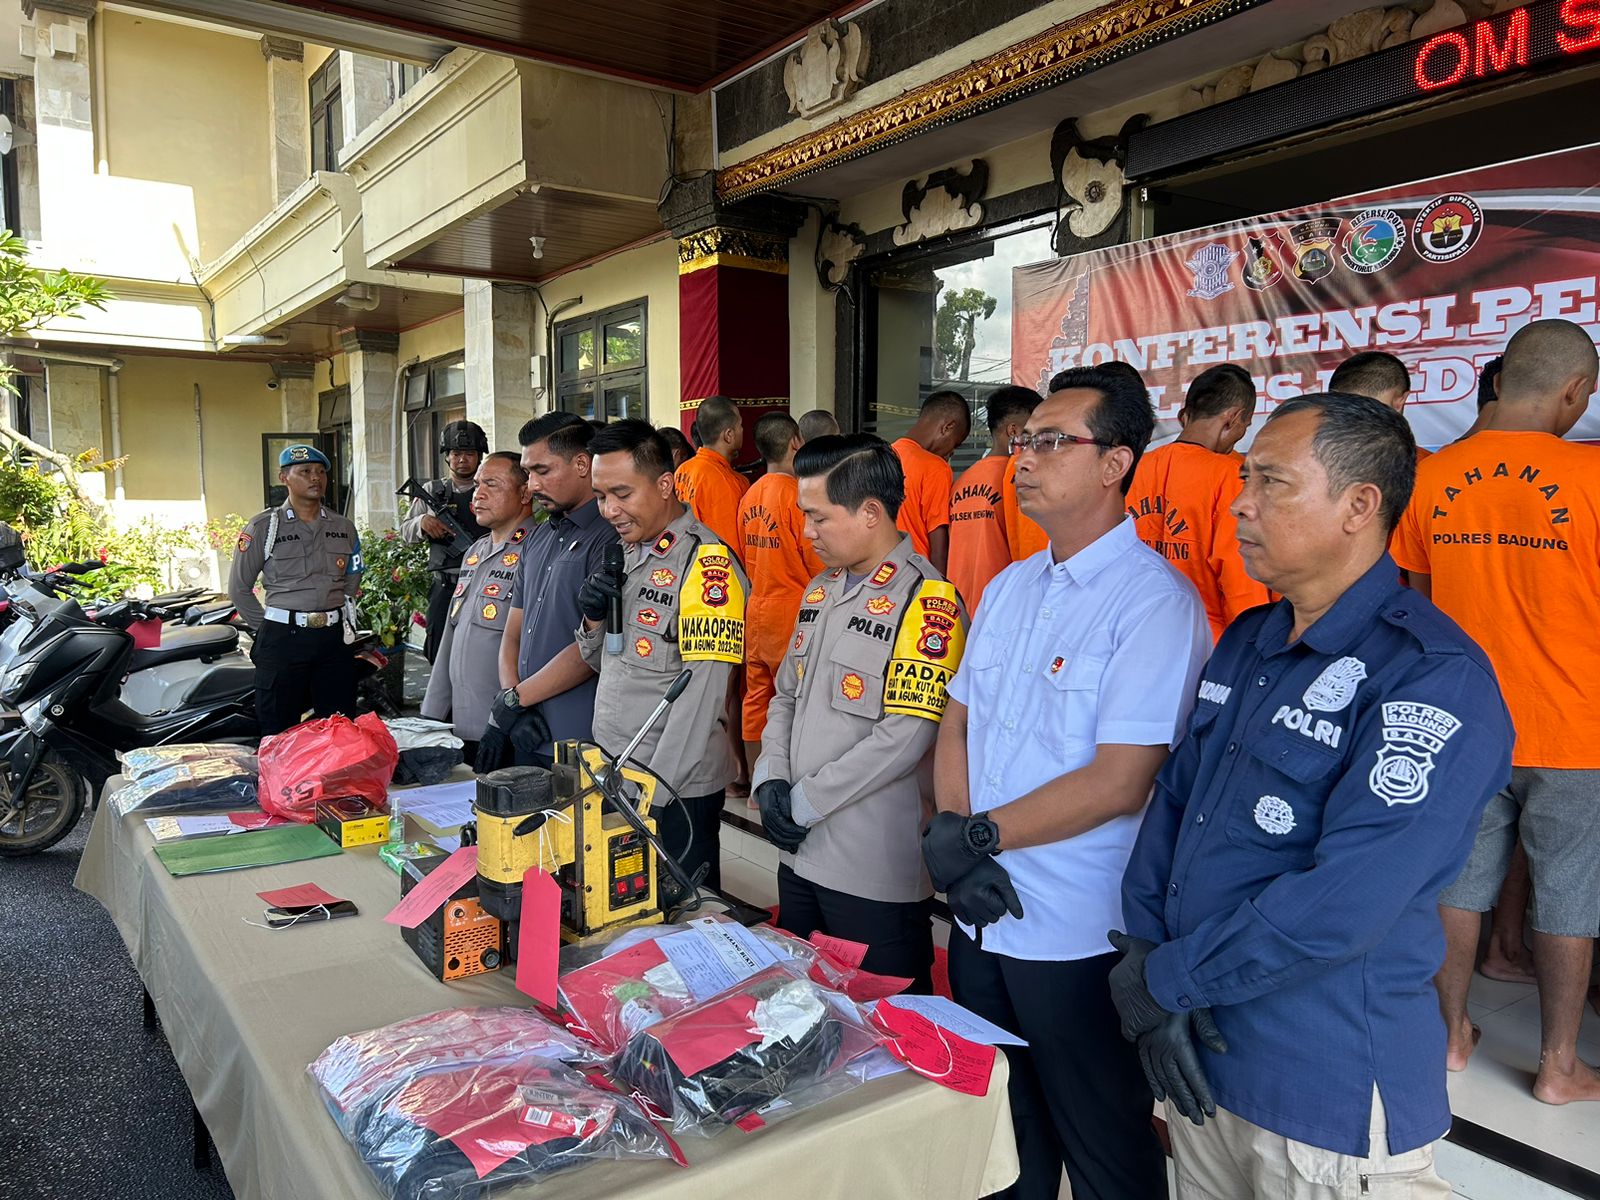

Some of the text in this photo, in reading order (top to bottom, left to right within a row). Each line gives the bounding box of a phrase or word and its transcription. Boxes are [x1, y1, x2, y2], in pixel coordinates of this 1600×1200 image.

[1414, 8, 1530, 91] OM
[1449, 196, 1480, 223] DIPERCAYA
[1351, 209, 1405, 237] RESERSE POLRI
[1049, 294, 1458, 377] KONFERENSI
[1432, 462, 1570, 525] TAHANAN
[325, 531, 348, 539] POLRI
[1433, 533, 1568, 550] POLRES BADUNG
[488, 570, 515, 581] POLRI
[638, 587, 673, 607] POLRI
[681, 617, 743, 643] WAKAOPSRES
[847, 616, 893, 642] POLRI
[929, 614, 949, 625] BALI
[694, 639, 715, 652] AGUNG
[898, 691, 923, 704] AGUNG
[916, 681, 935, 693] KUTA
[1271, 705, 1342, 749] POLRI
[1387, 705, 1454, 727] POLRES
[1388, 714, 1449, 736] BADUNG
[1389, 729, 1438, 747] BALI
